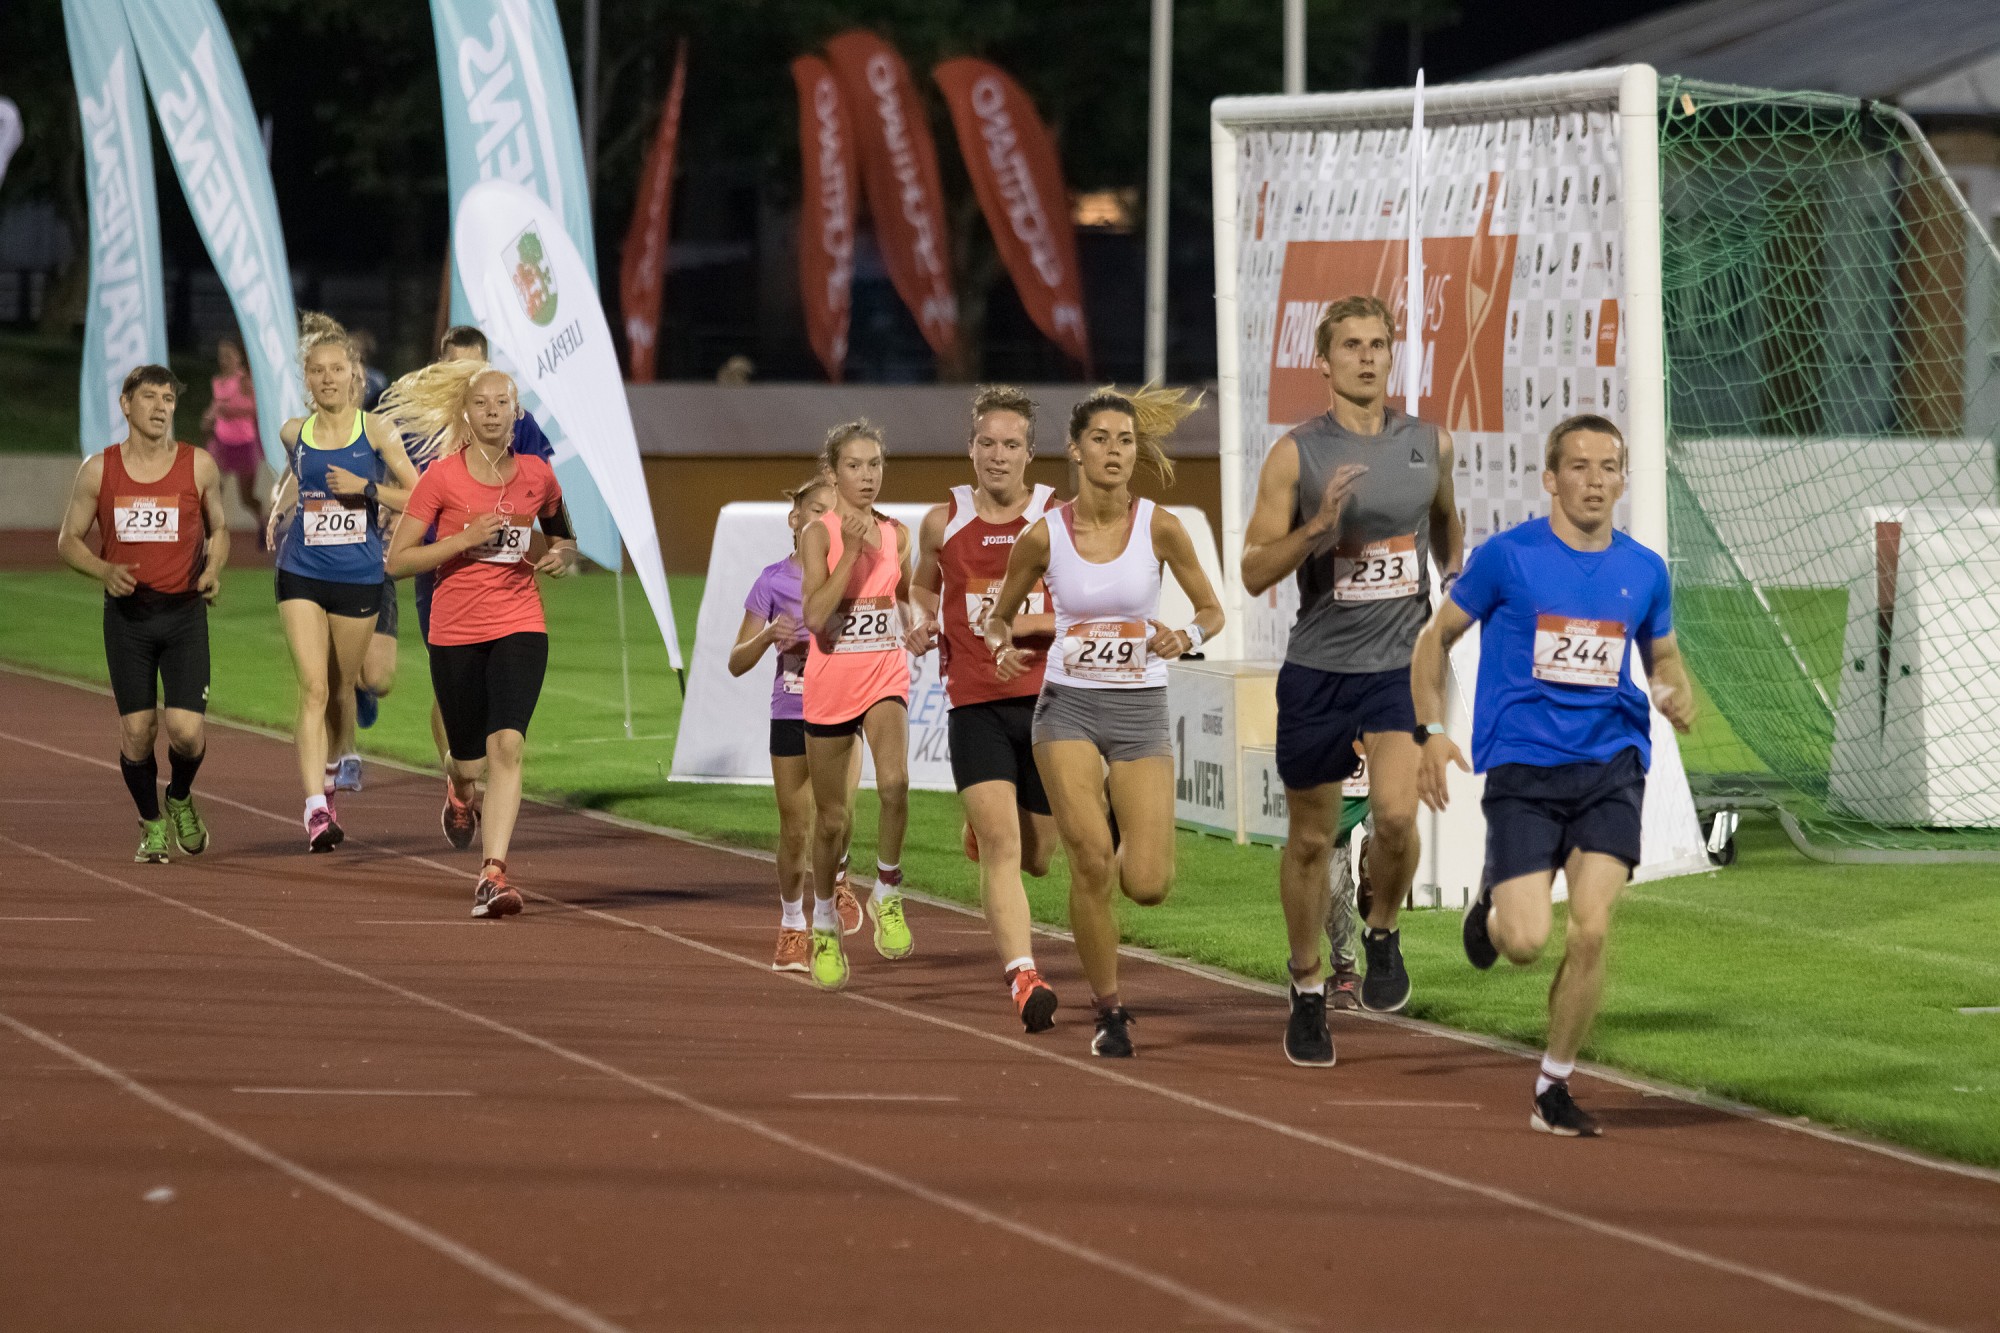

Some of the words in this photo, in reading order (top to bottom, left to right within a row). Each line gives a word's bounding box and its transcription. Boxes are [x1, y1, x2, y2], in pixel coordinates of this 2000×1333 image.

[126, 510, 168, 528] 239
[315, 513, 357, 532] 206
[482, 529, 521, 548] 18
[1350, 556, 1404, 583] 233
[841, 612, 888, 637] 228
[1078, 640, 1134, 665] 249
[1552, 636, 1609, 666] 244
[1176, 715, 1193, 804] 1.
[1194, 759, 1225, 810] VIETA
[1262, 768, 1272, 817] 3.
